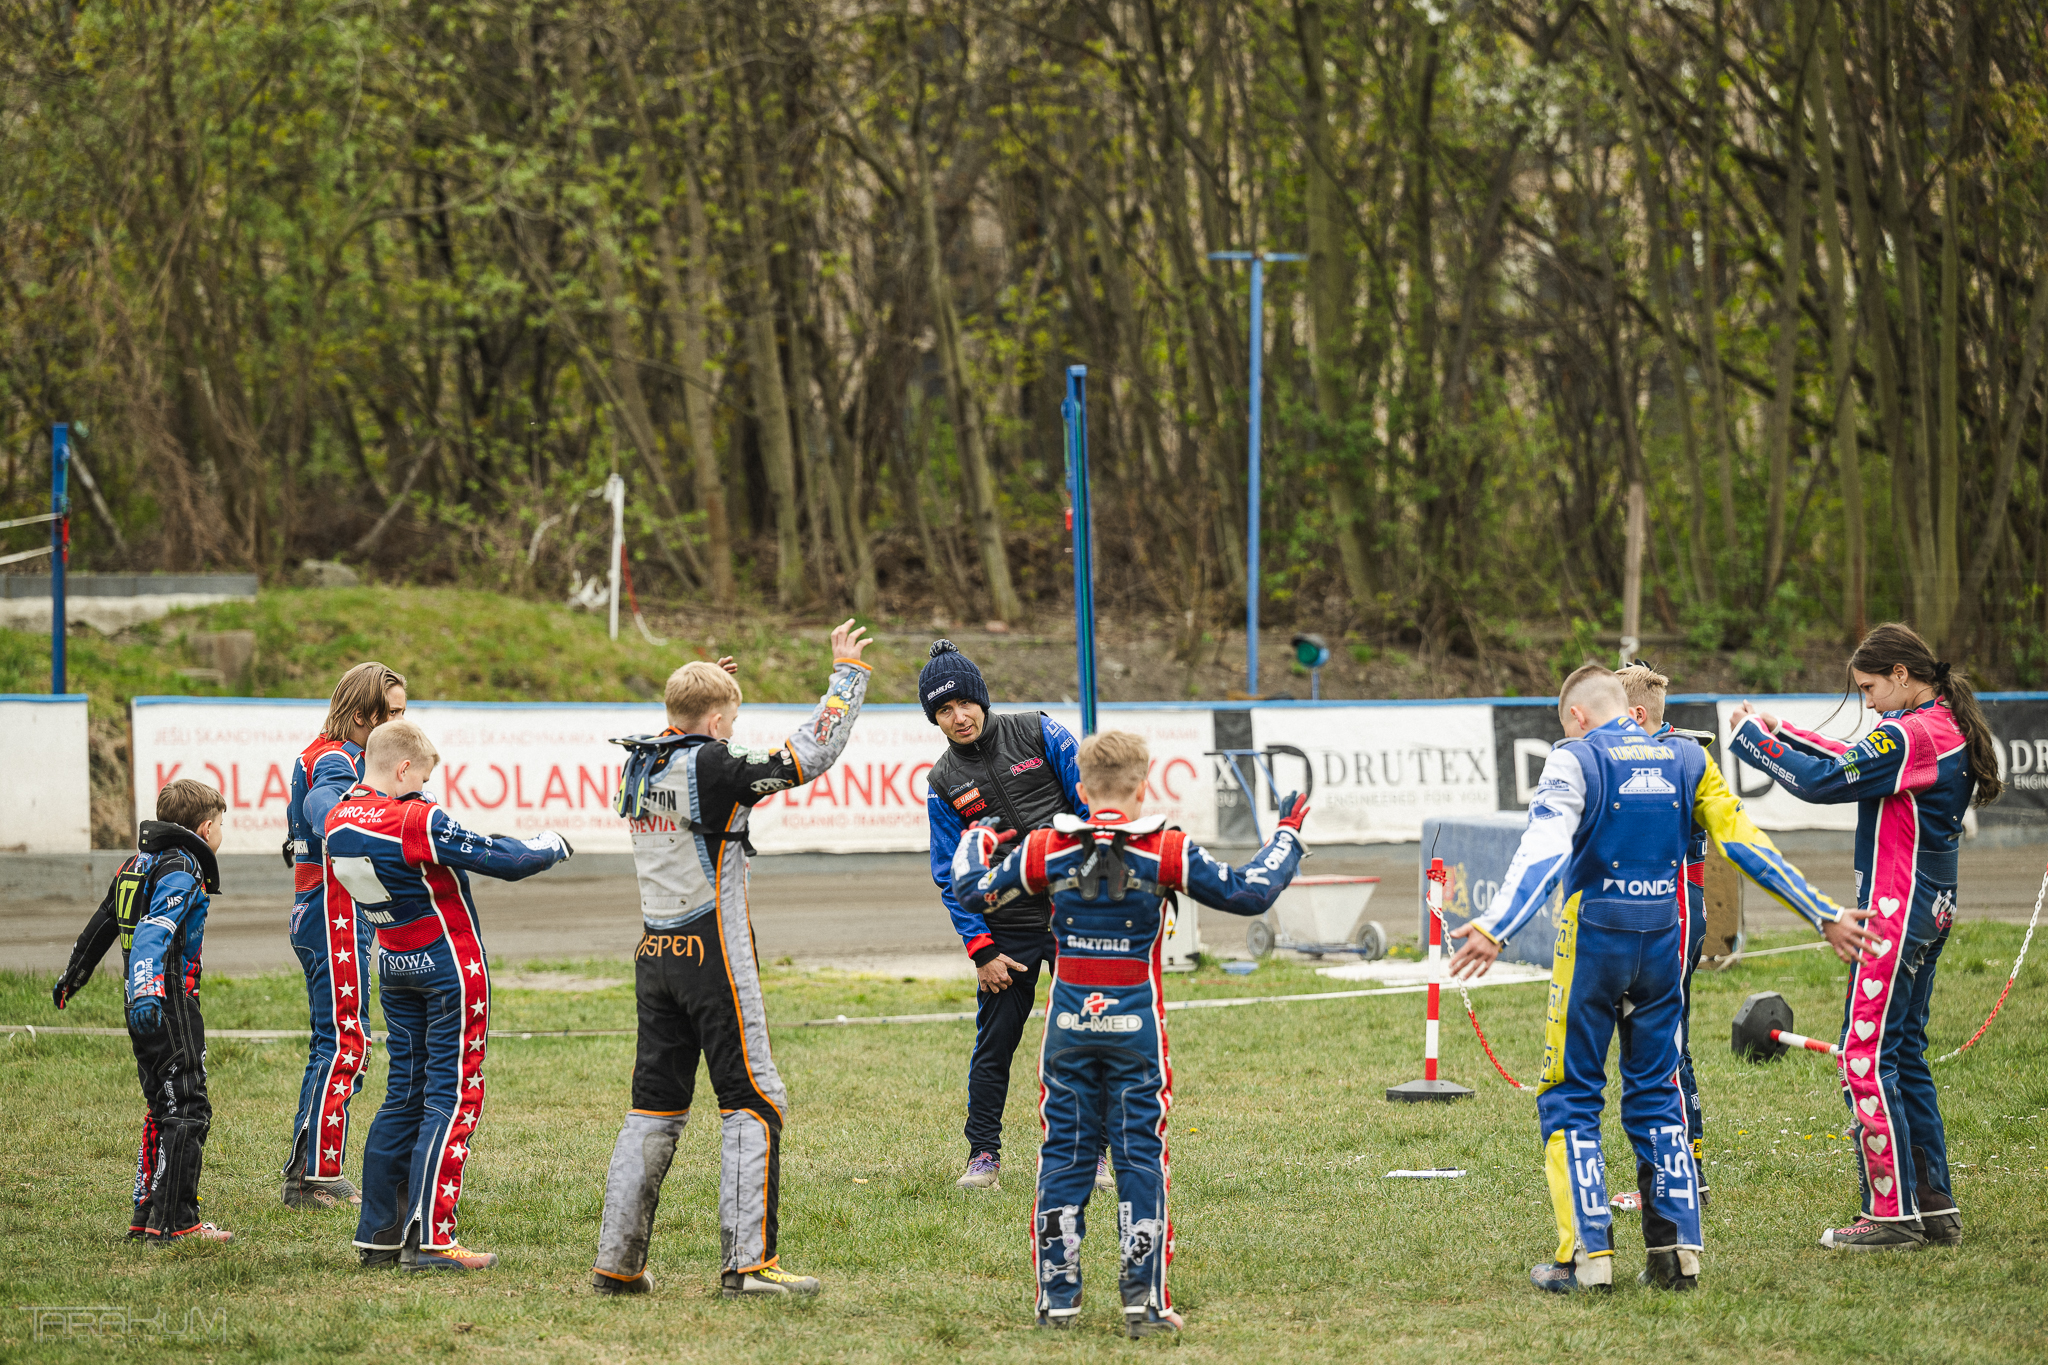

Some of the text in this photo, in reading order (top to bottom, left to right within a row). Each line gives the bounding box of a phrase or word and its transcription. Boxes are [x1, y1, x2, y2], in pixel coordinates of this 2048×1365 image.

[1736, 733, 1799, 787] AUTO-DIESEL
[1867, 730, 1896, 754] ES
[156, 761, 291, 808] KOLA
[443, 763, 623, 809] KOLAN
[1322, 748, 1489, 786] DRUTEX
[119, 880, 139, 919] 17
[388, 951, 435, 971] SOWA
[1057, 1011, 1143, 1033] OL-MED
[1571, 1130, 1608, 1217] FST
[1660, 1125, 1695, 1209] FST
